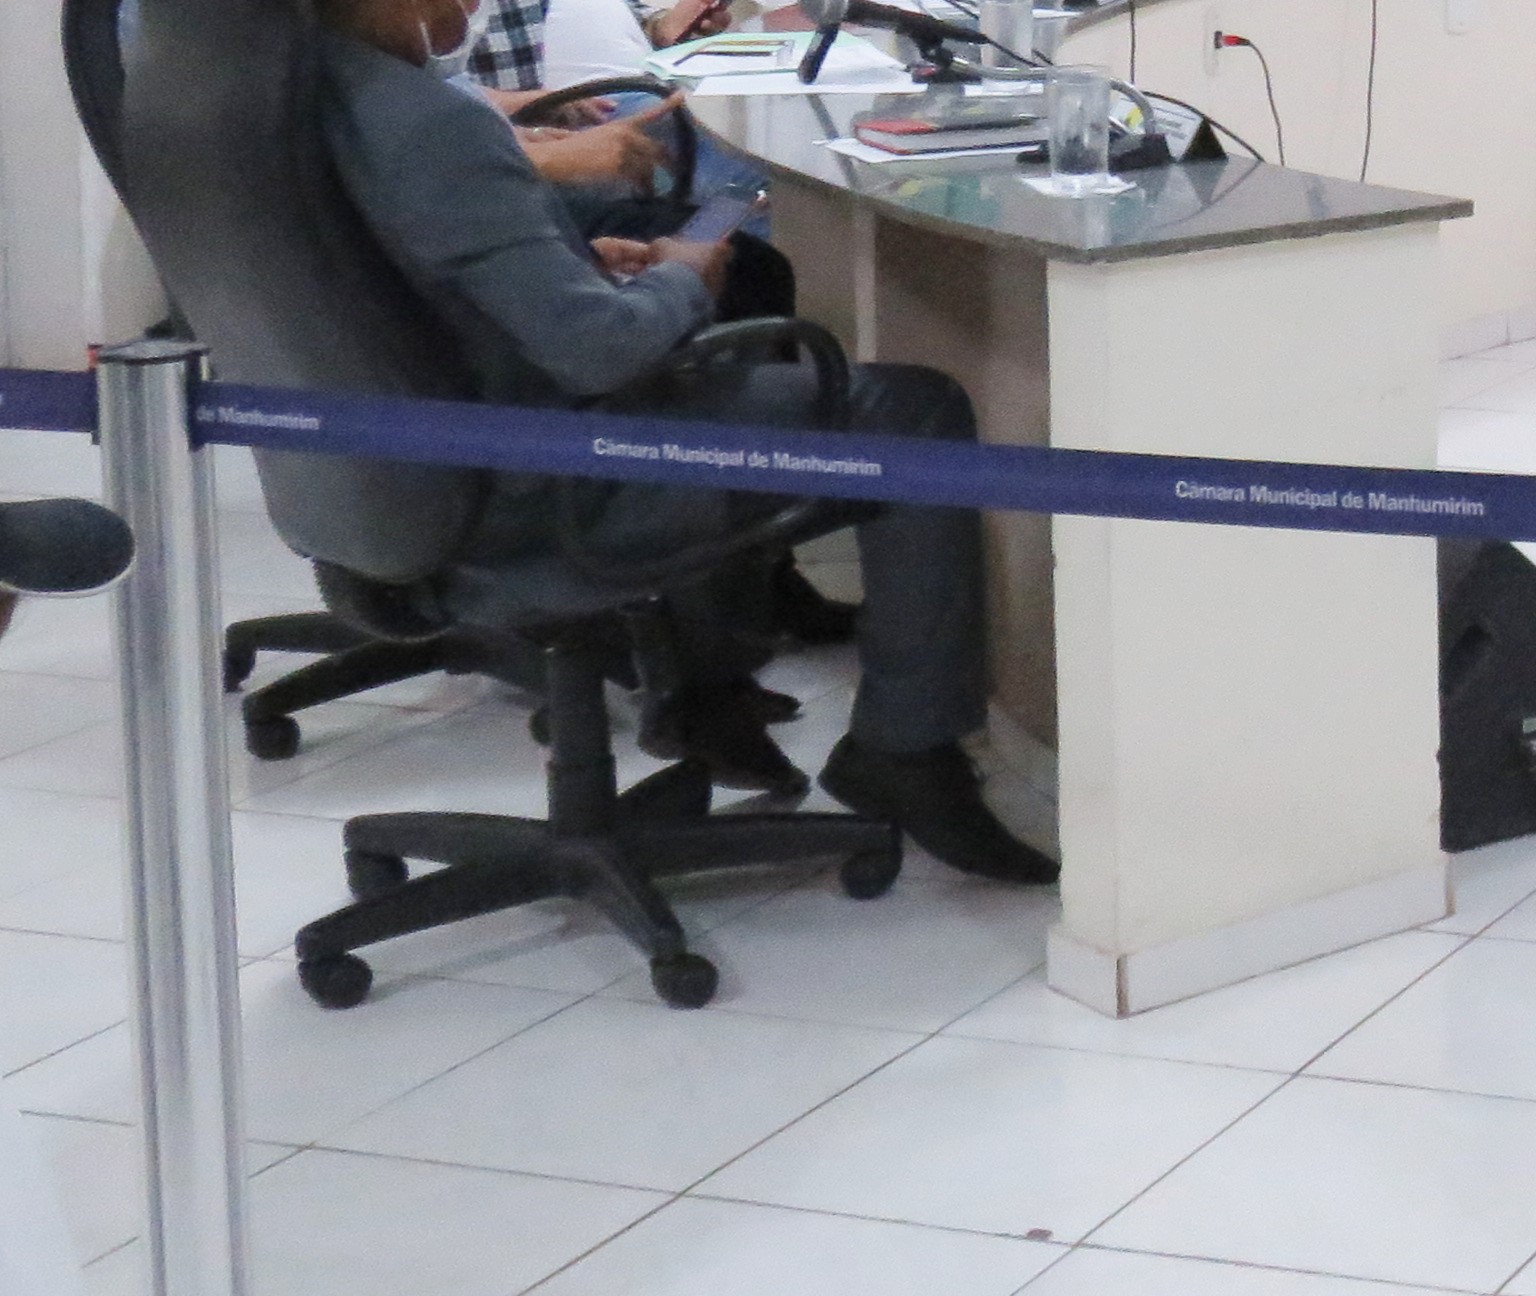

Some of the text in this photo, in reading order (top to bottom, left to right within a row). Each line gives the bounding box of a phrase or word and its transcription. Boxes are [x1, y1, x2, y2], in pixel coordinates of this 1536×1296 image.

[218, 407, 319, 430] Manhumirim
[663, 444, 744, 468] Municipal
[748, 452, 769, 468] de
[774, 452, 882, 475] Manhumirim
[1175, 480, 1485, 515] Câmara Municipal de Manhumirim
